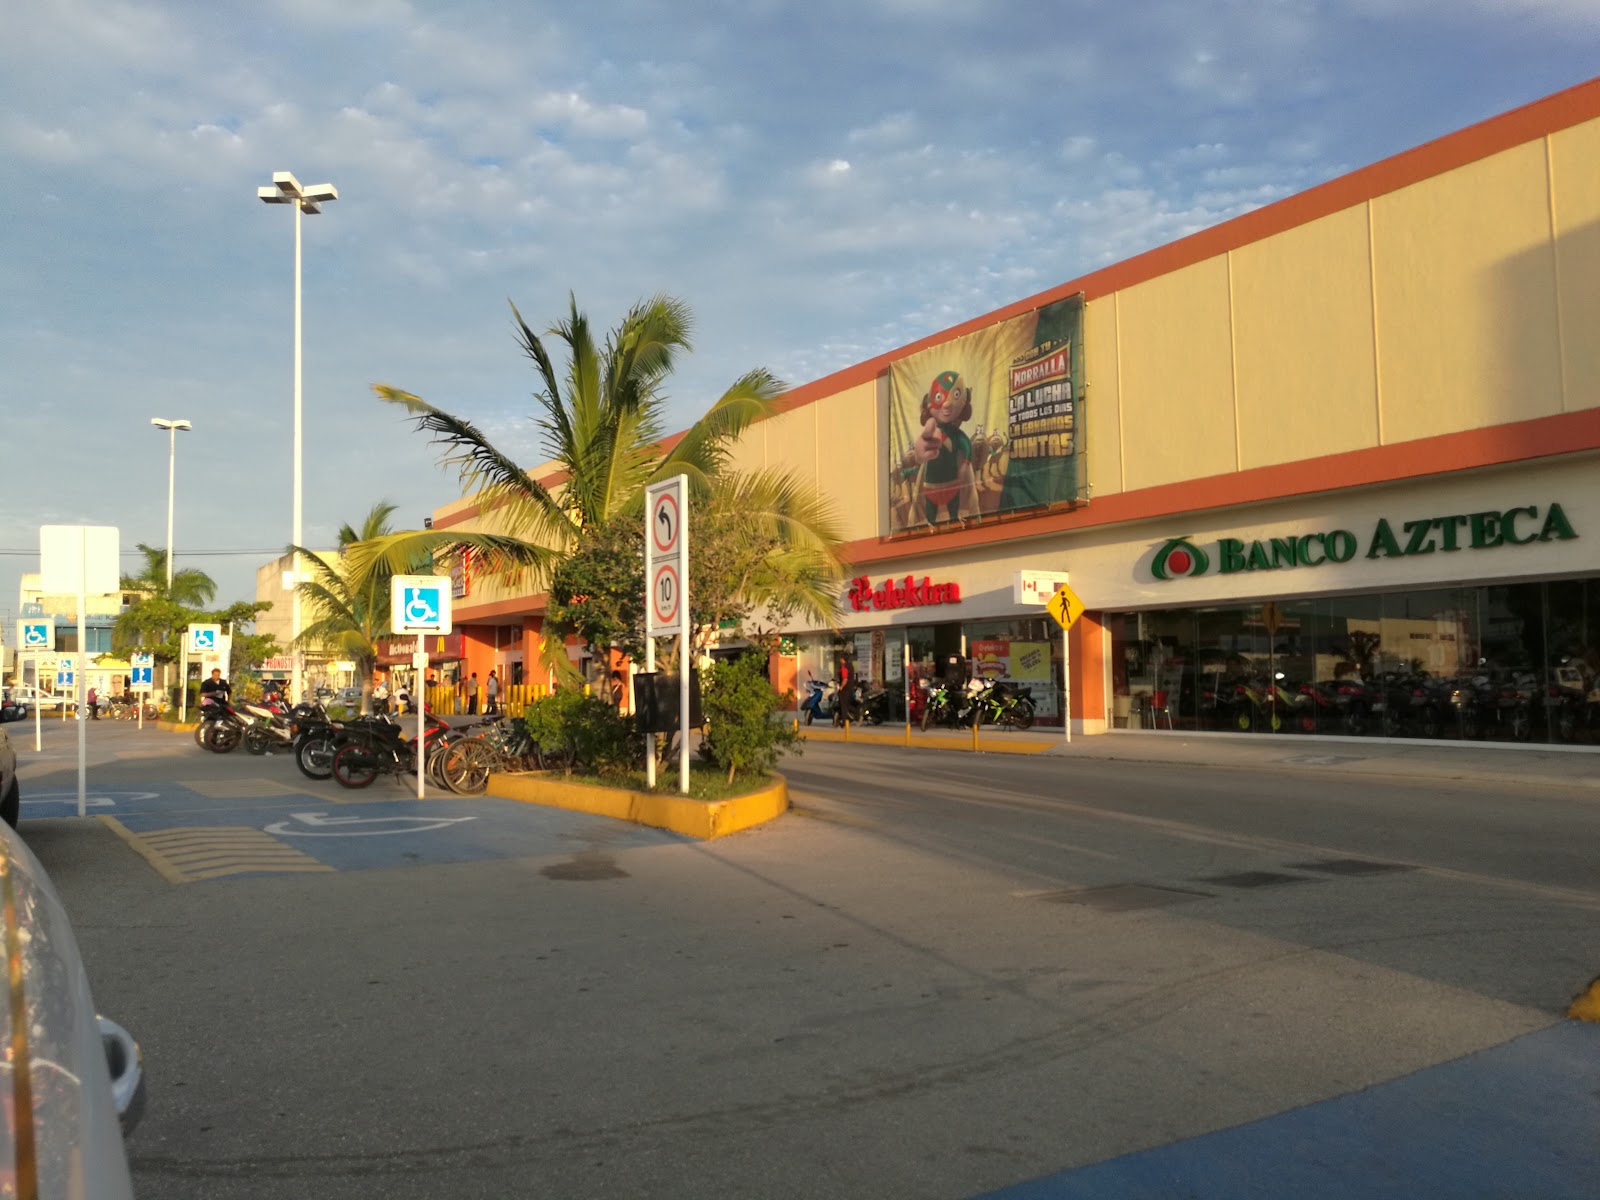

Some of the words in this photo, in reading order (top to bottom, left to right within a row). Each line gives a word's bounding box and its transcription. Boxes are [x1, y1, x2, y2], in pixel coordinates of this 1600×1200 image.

[1041, 341, 1051, 352] TU
[1014, 354, 1065, 387] MORRALLA
[1010, 394, 1024, 413] LA
[1027, 382, 1072, 408] LUCHA
[1018, 409, 1038, 420] TODOS
[1039, 405, 1052, 416] LOS
[1021, 415, 1073, 434] GANAMOS
[1010, 432, 1073, 459] JUNTAS
[1218, 529, 1357, 574] BANCO
[1366, 502, 1579, 559] AZTECA
[660, 577, 672, 602] 10
[872, 575, 962, 611] elektra
